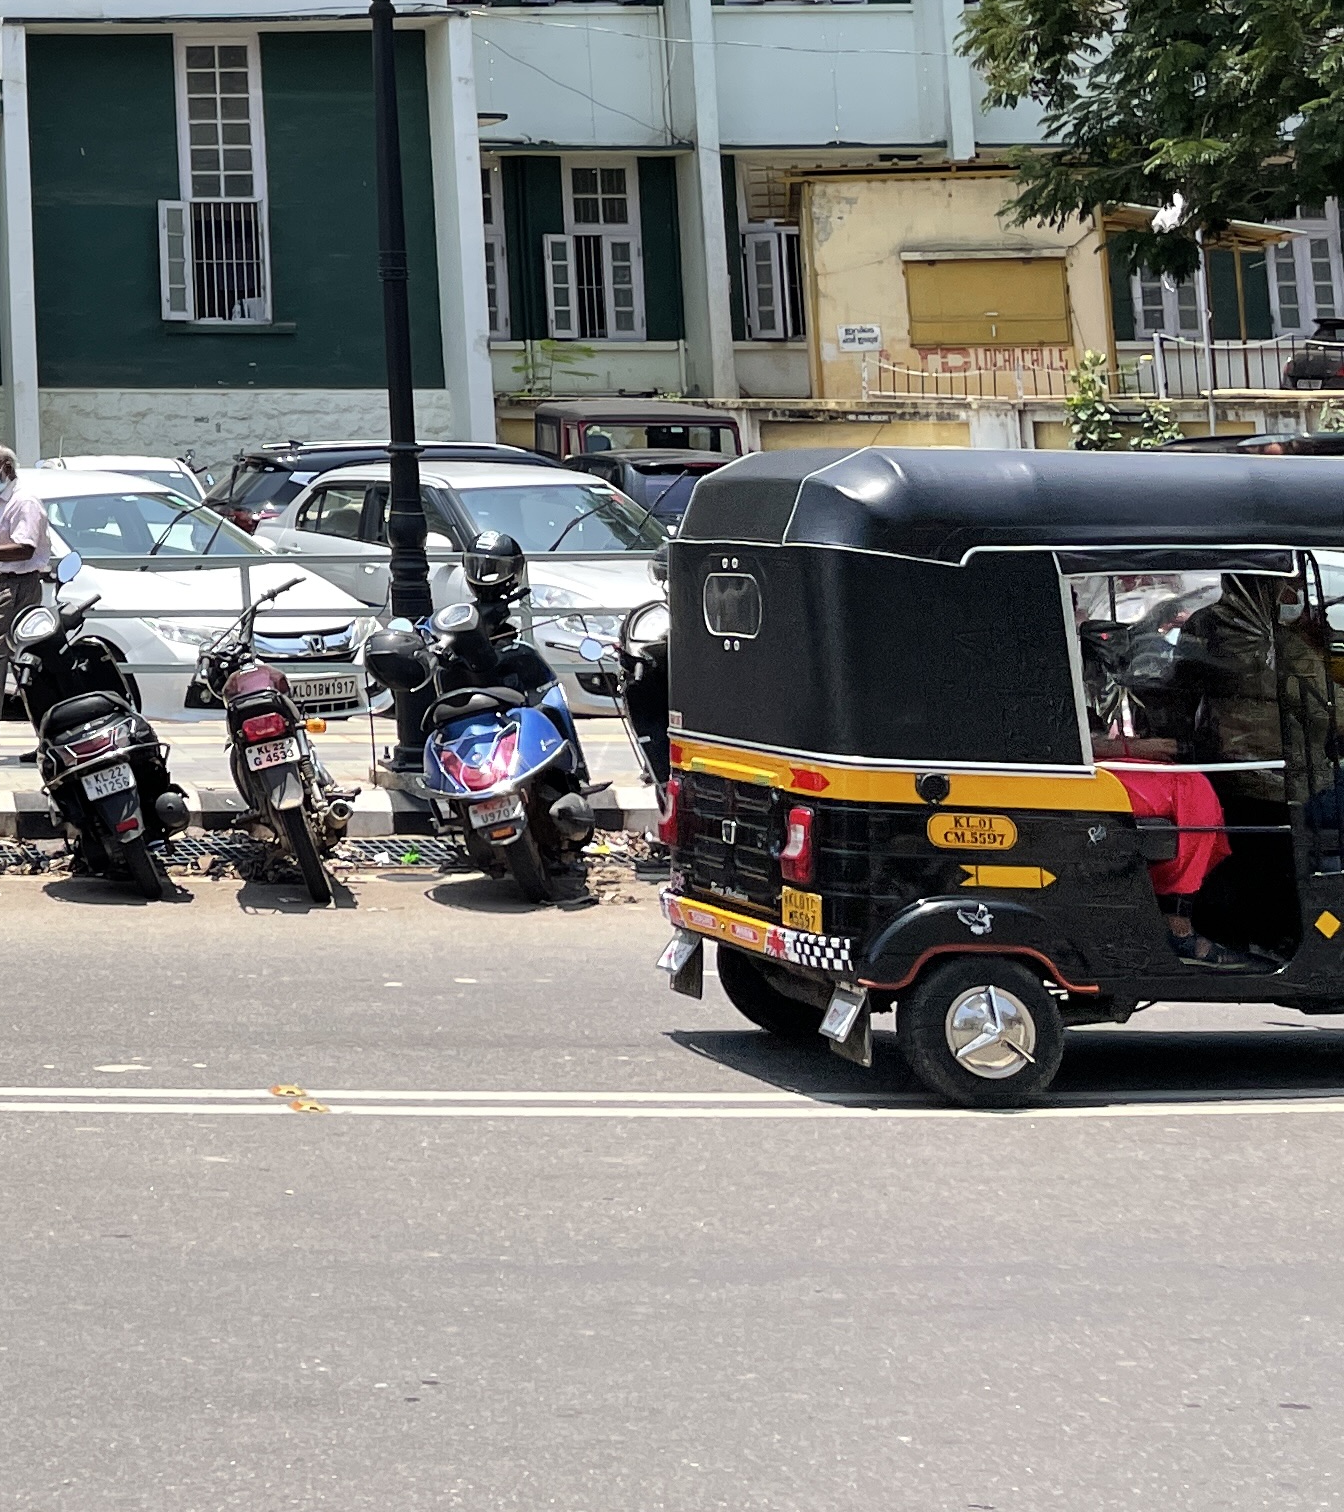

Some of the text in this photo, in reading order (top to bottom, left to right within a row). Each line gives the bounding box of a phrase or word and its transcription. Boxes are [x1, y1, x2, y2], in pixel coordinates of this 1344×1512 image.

[974, 347, 1018, 371] LOCAL
[1020, 347, 1070, 371] CALLS
[293, 680, 355, 698] KL01BW1917
[257, 742, 285, 755] KL 22
[94, 766, 123, 784] KL 22
